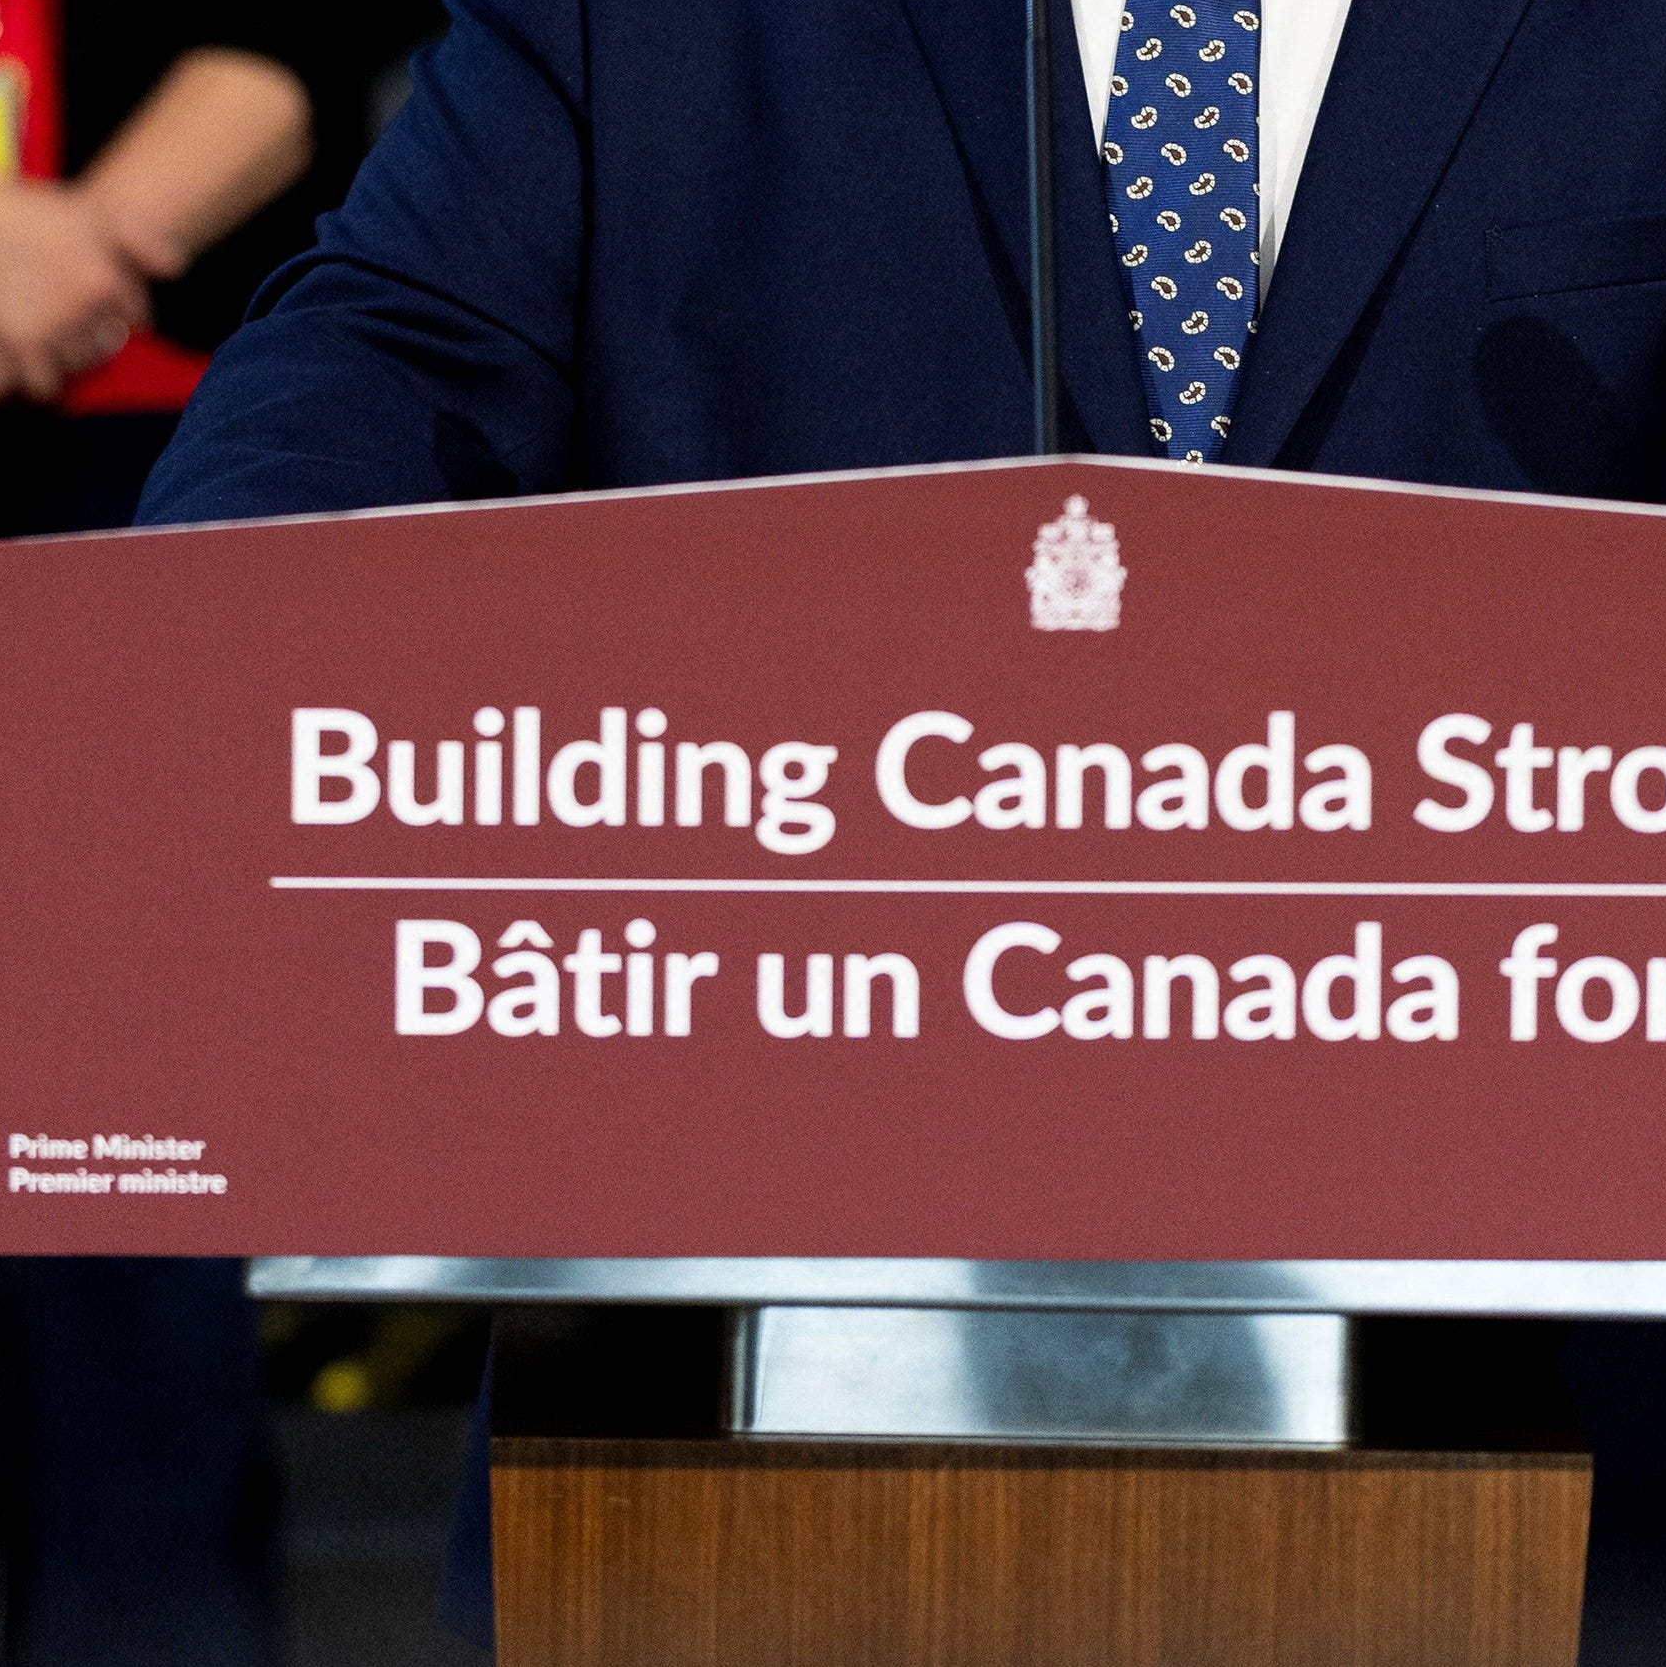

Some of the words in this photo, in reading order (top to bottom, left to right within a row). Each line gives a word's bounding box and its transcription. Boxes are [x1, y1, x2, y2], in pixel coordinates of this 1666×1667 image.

[290, 706, 840, 856] Building
[874, 710, 1374, 833] Canada
[393, 917, 721, 1039] Bâtir
[756, 952, 921, 1040] un
[962, 920, 1460, 1044] Canada
[8, 1132, 89, 1160] Prime
[91, 1133, 207, 1161] Minister
[8, 1166, 116, 1194] Premier
[118, 1167, 229, 1195] ministre
